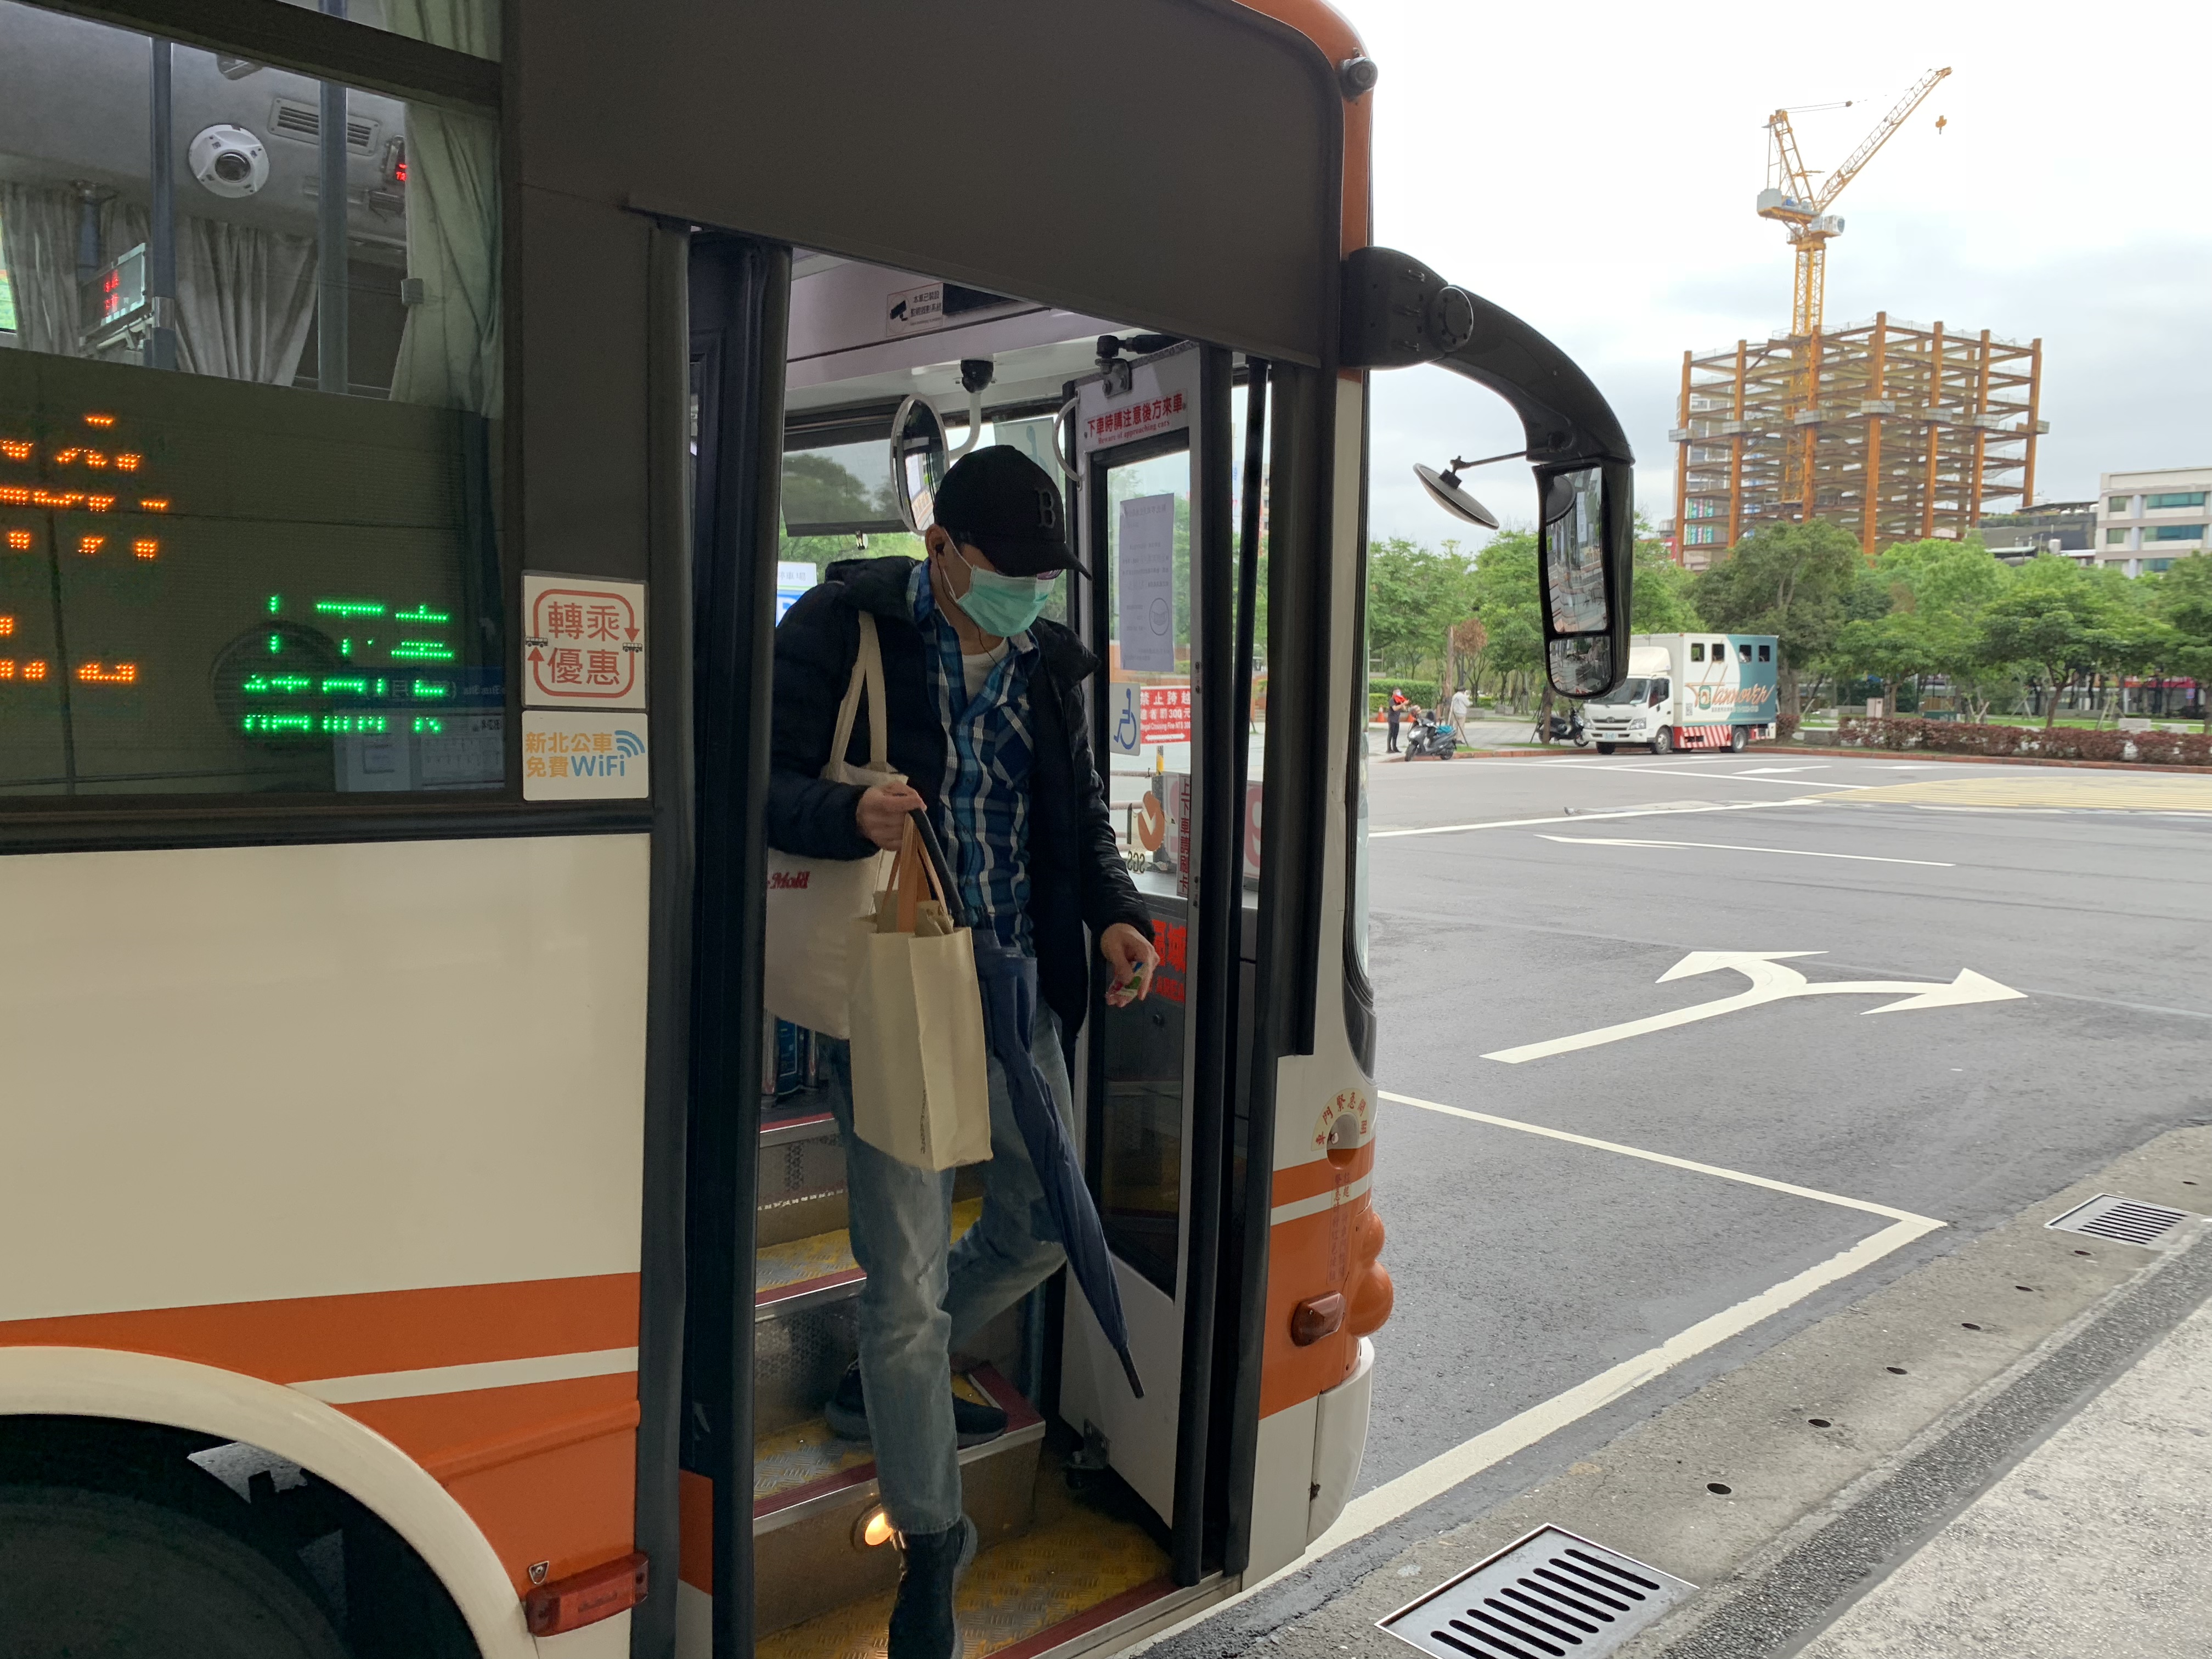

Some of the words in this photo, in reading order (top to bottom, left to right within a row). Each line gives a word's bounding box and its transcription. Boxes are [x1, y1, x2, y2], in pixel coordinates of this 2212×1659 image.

[1088, 393, 1183, 438] 下車時請注意後方來車
[1124, 423, 1156, 439] approaching
[1158, 420, 1170, 429] cars
[548, 601, 620, 642] 轉乘
[548, 647, 620, 686] 優惠
[1141, 691, 1190, 706] 禁止跨越
[526, 731, 613, 753] 新北公車
